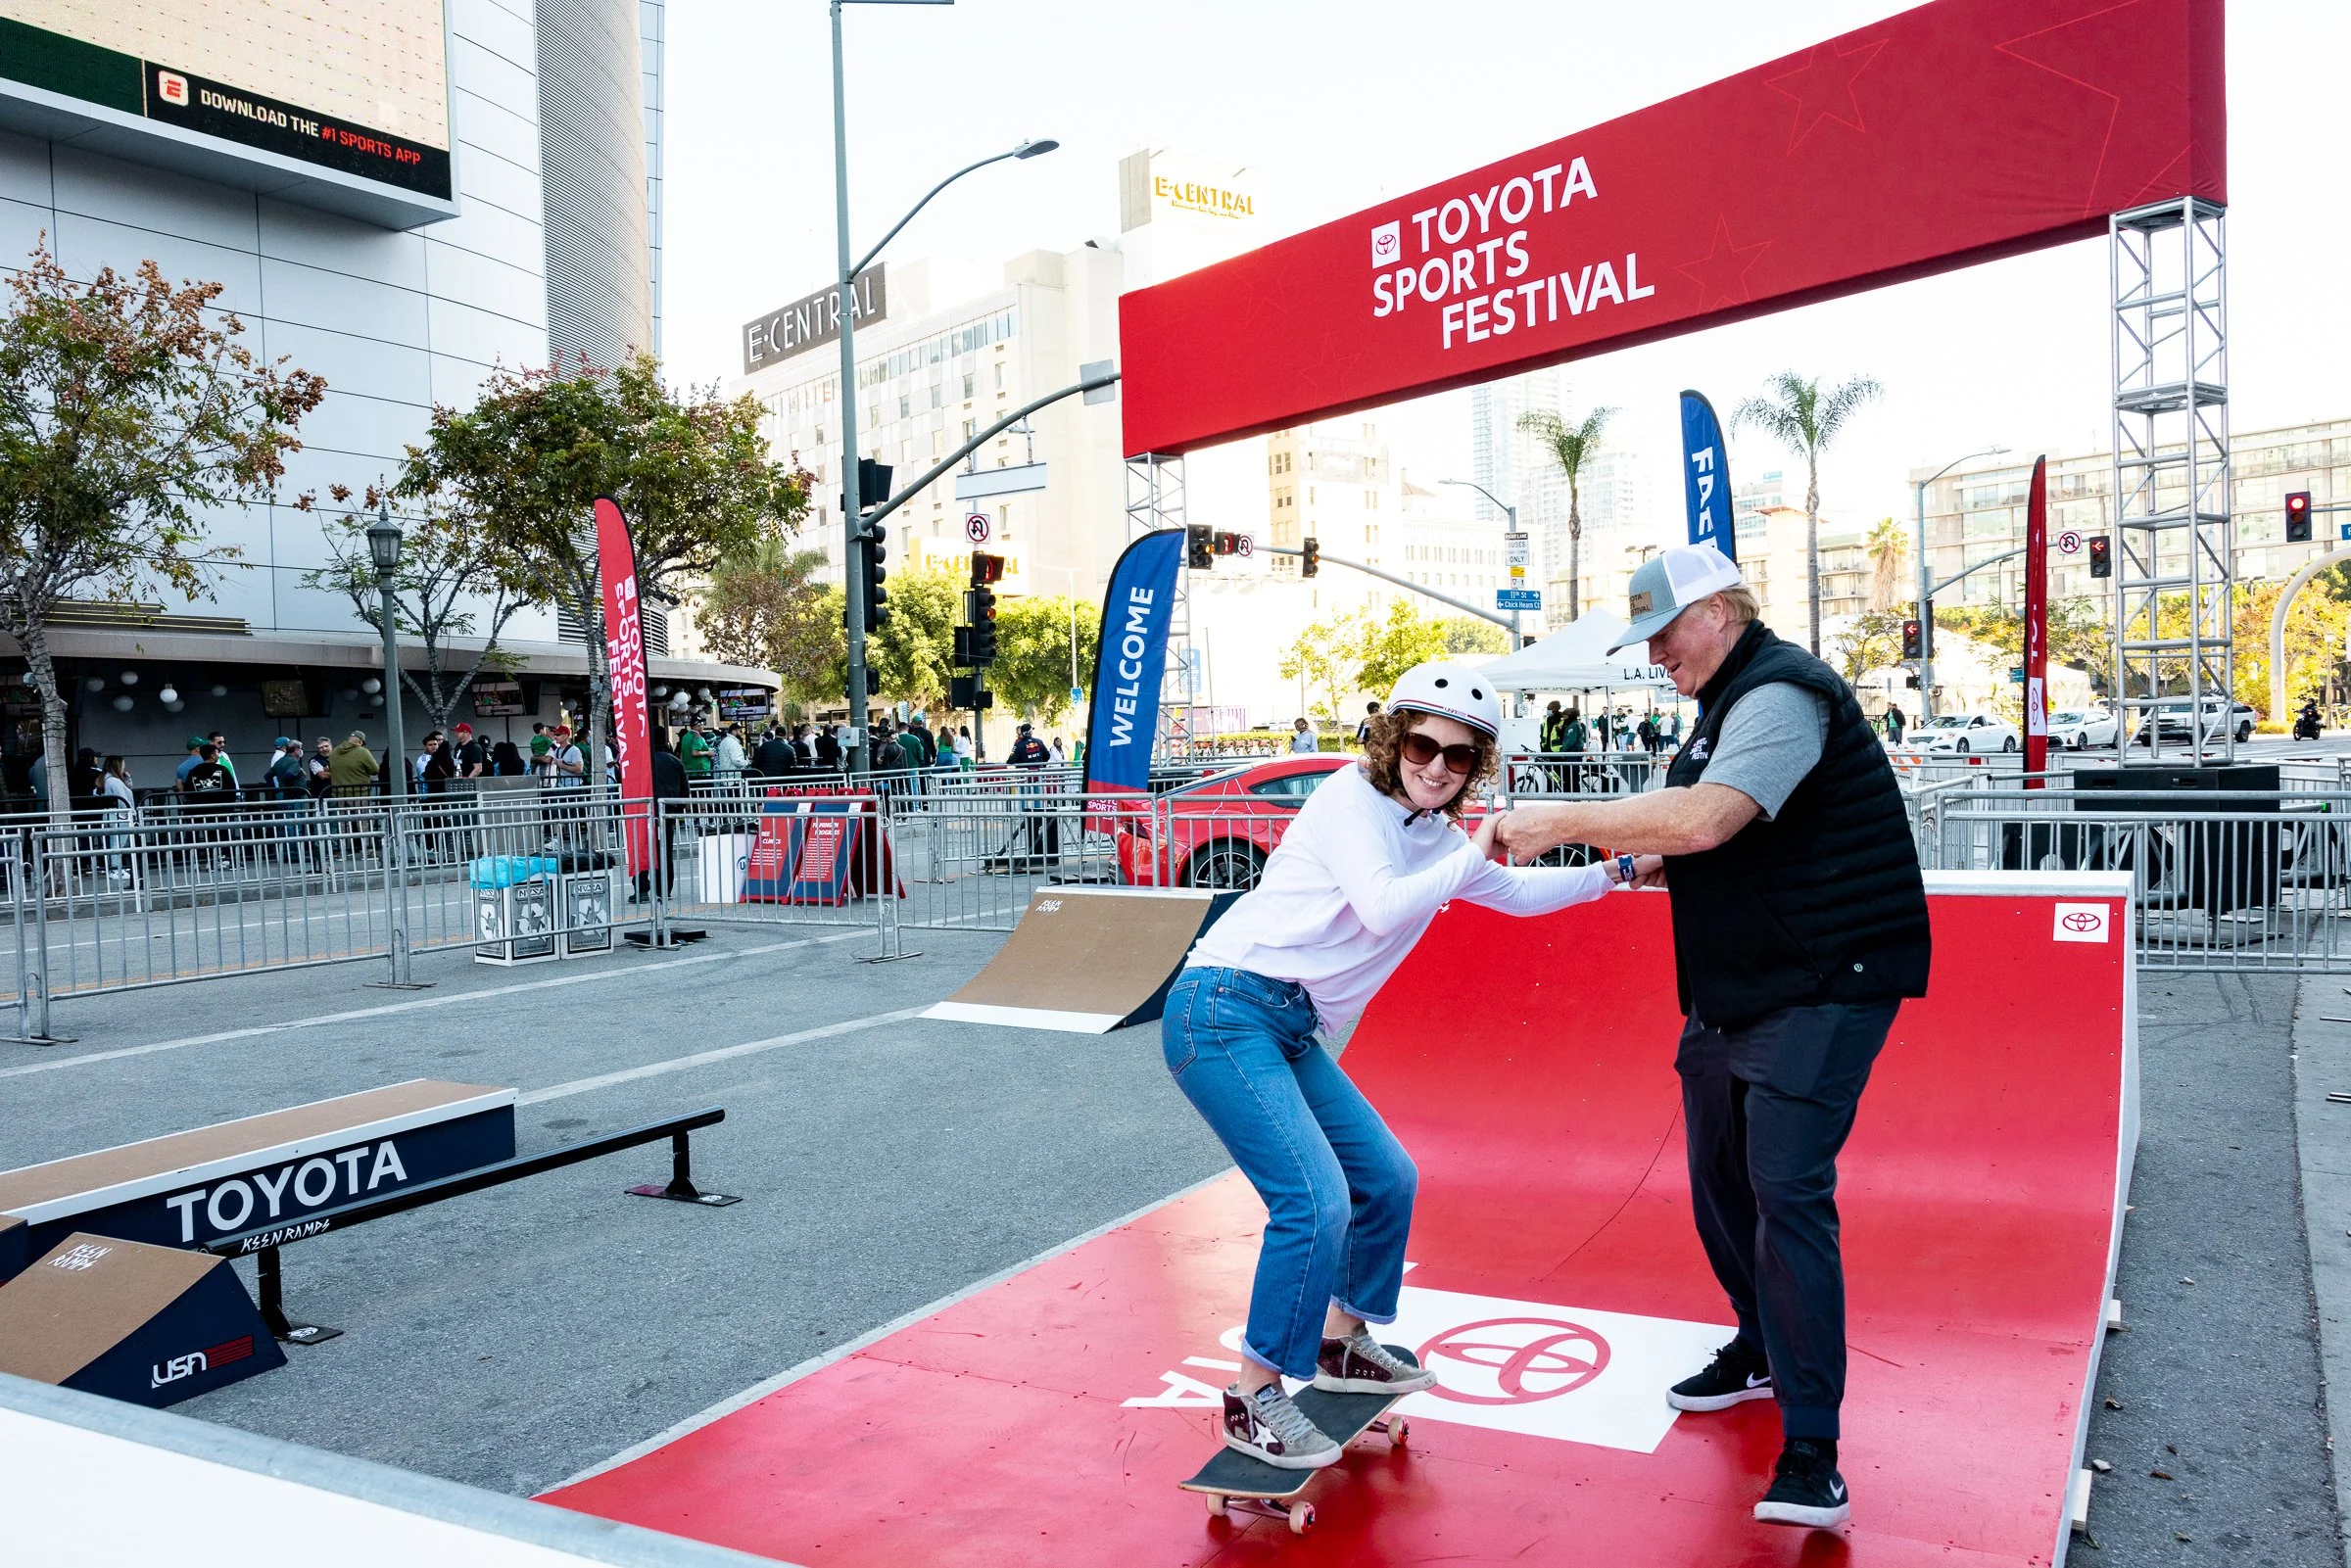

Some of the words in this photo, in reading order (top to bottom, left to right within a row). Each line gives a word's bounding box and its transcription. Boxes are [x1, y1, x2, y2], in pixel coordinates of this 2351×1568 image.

[200, 89, 287, 128] DOWNLOAD
[290, 116, 319, 138] THE
[321, 125, 335, 141] #1
[340, 130, 392, 158] SPORTS
[395, 147, 421, 166] APP
[1412, 156, 1599, 254] TOYOTA
[1373, 230, 1529, 317] SPORTS
[1442, 252, 1655, 350] FESTIVAL
[615, 582, 634, 696] SPORTS
[1110, 587, 1154, 746] WELCOME
[1624, 668, 1645, 680] L.A.
[608, 638, 630, 779] FESTIVAL
[1087, 801, 1118, 813] SPORTS
[167, 1140, 408, 1243] TOYOTA
[47, 1256, 99, 1270] RAMPS
[67, 1243, 113, 1259] KEEN
[240, 1231, 283, 1253] KEEN
[284, 1218, 330, 1241] RAMPS
[151, 1352, 207, 1389] USA
